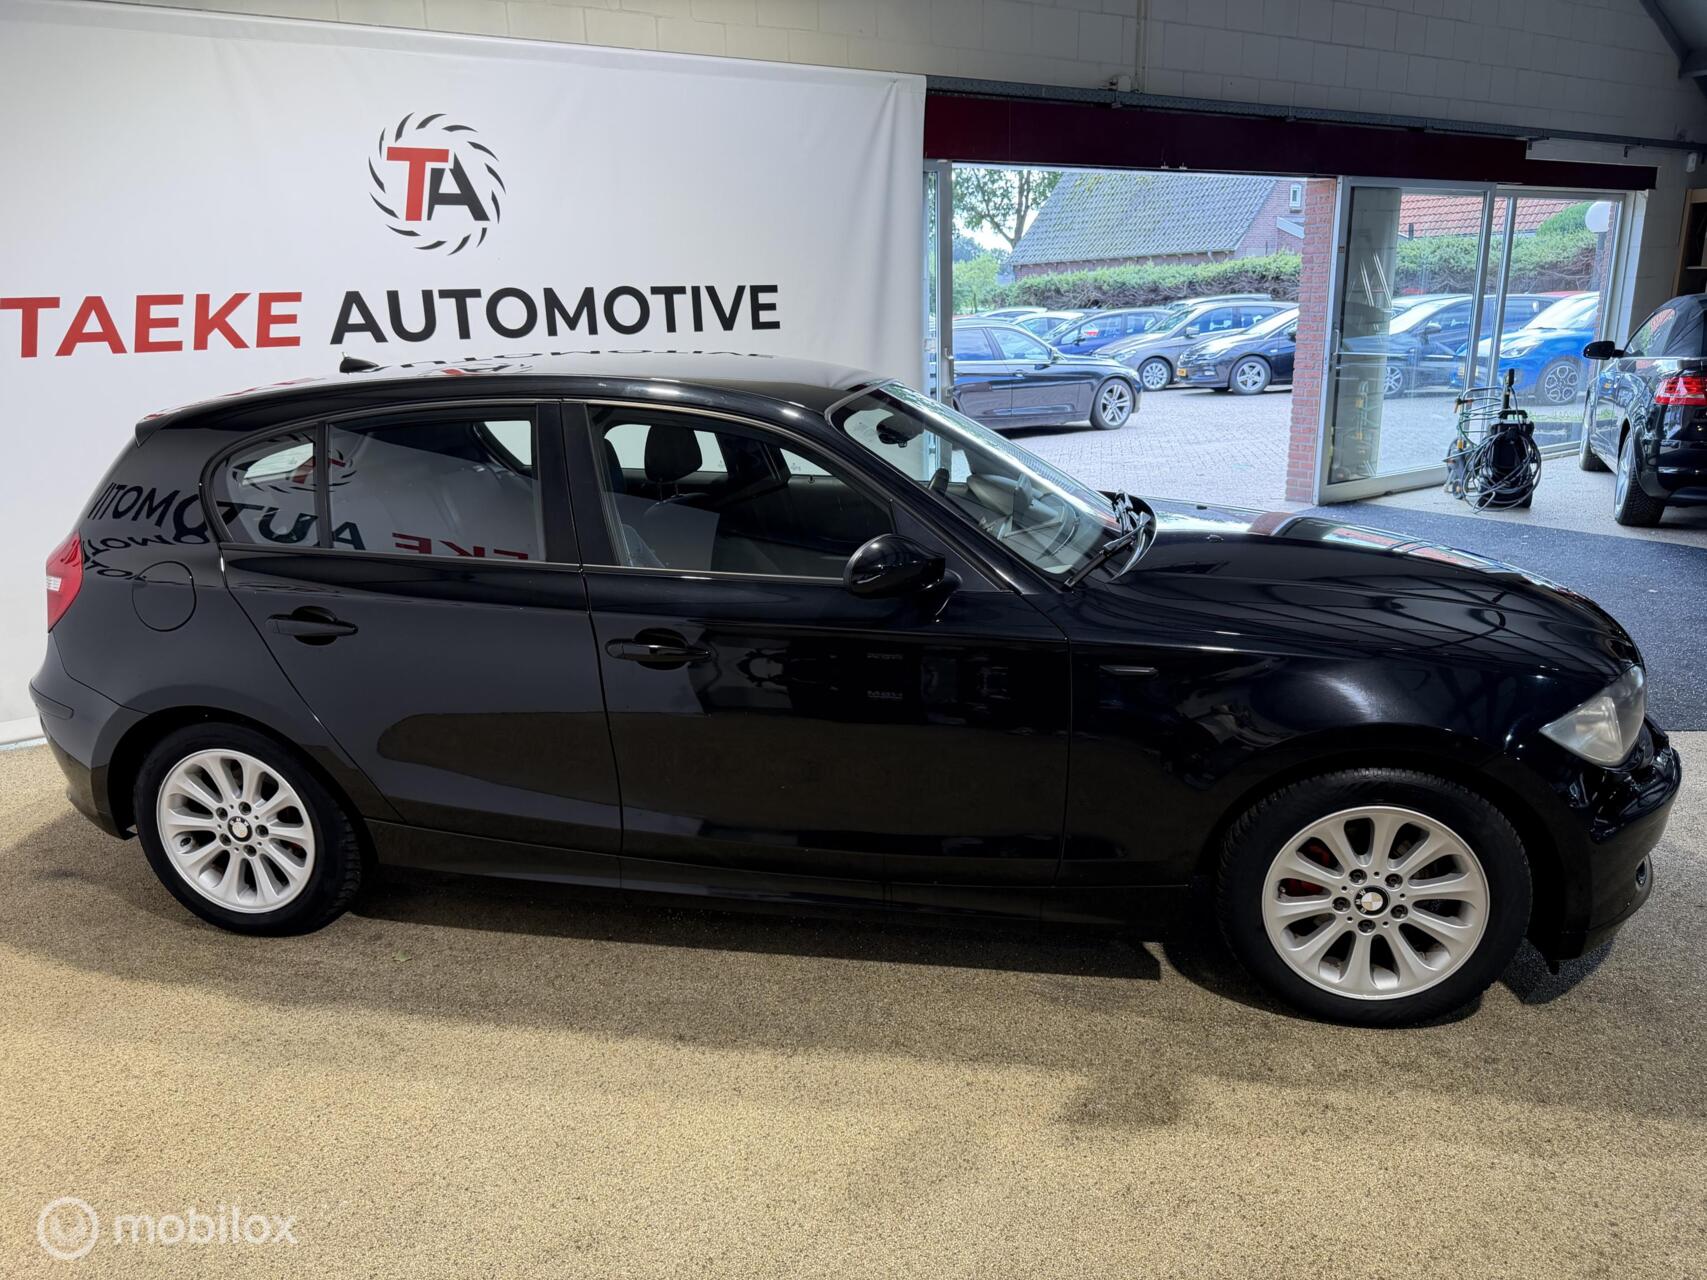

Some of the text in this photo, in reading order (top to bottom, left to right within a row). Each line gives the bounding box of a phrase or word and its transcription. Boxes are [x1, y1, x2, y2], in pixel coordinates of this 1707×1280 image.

[387, 147, 491, 221] TA
[0, 285, 780, 357] TAEKE AUTOMOTIVE
